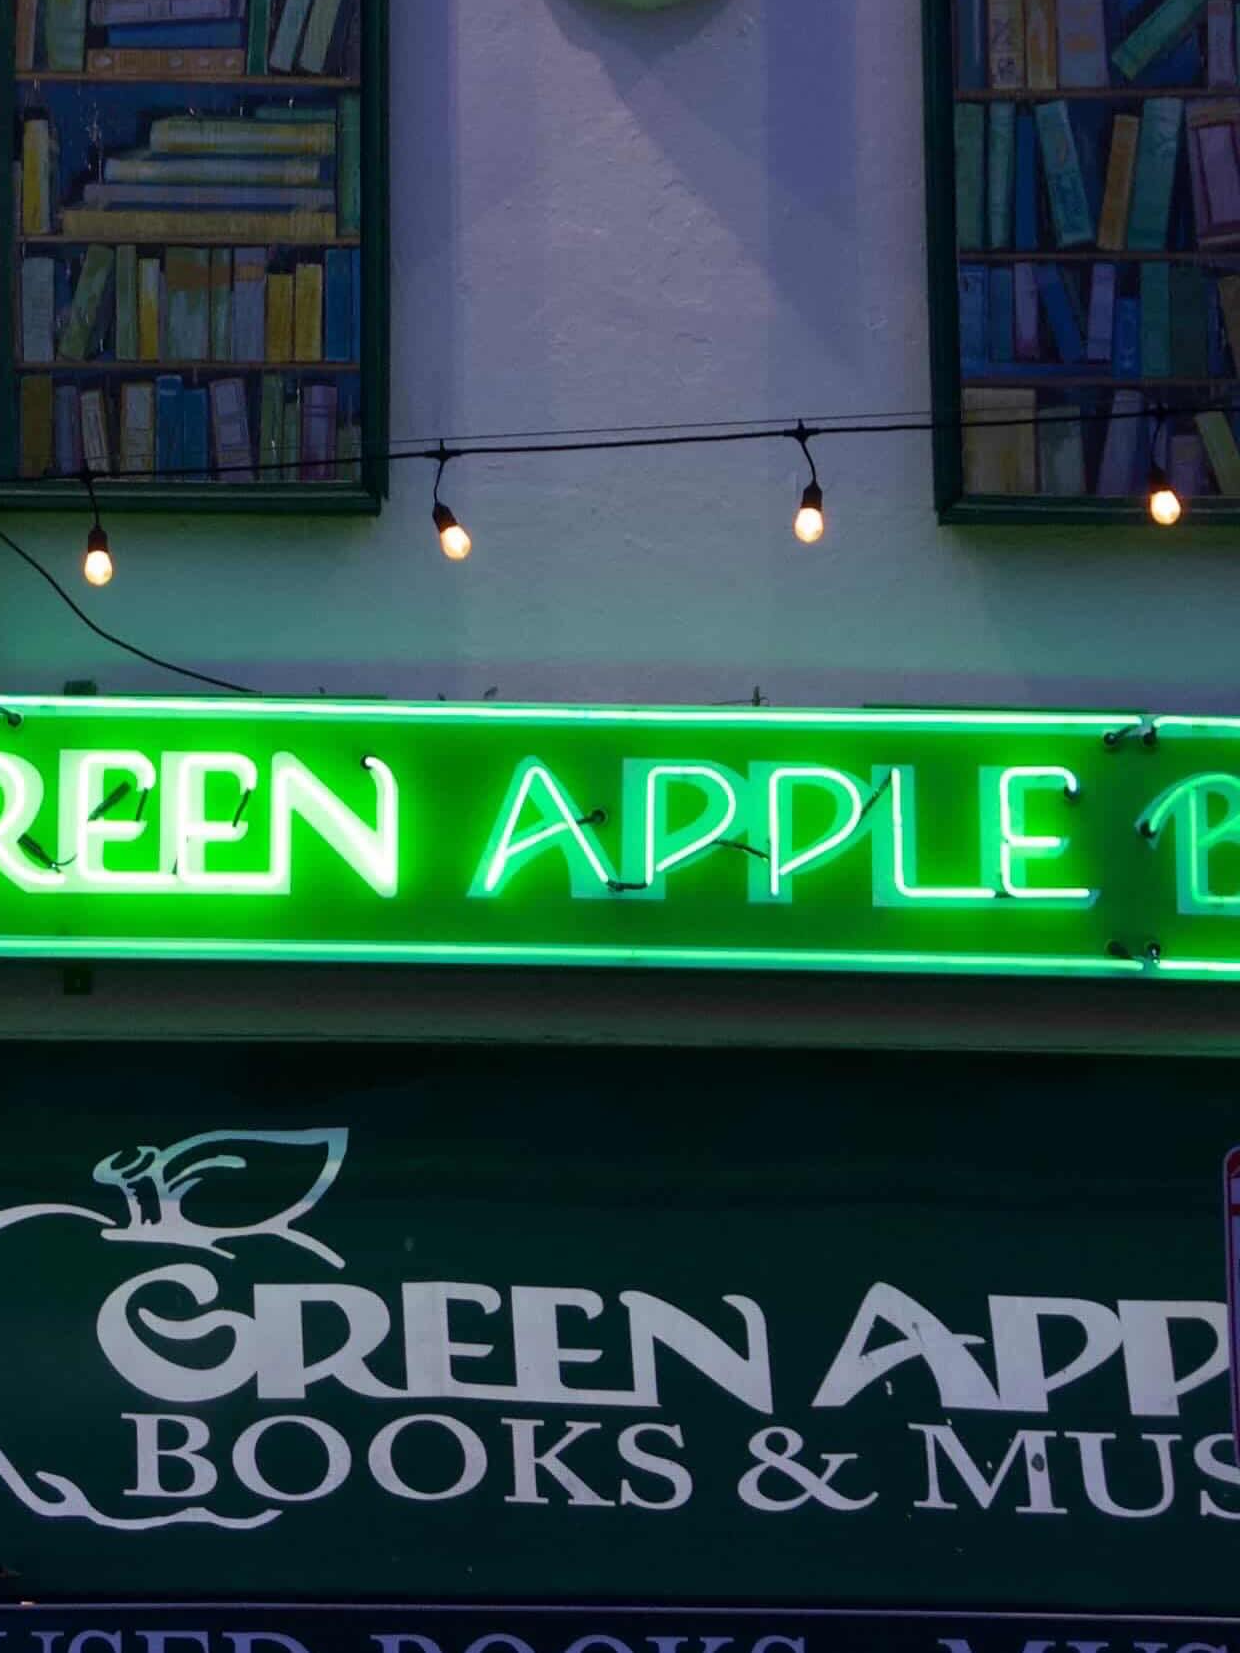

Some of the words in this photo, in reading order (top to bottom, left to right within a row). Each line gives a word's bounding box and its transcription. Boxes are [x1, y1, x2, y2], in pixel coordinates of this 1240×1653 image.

[466, 754, 1099, 908] APPLE
[96, 1262, 774, 1414] GREEN
[811, 1281, 1231, 1416] APP
[120, 1412, 693, 1511] BOOKS
[737, 1426, 879, 1512] &
